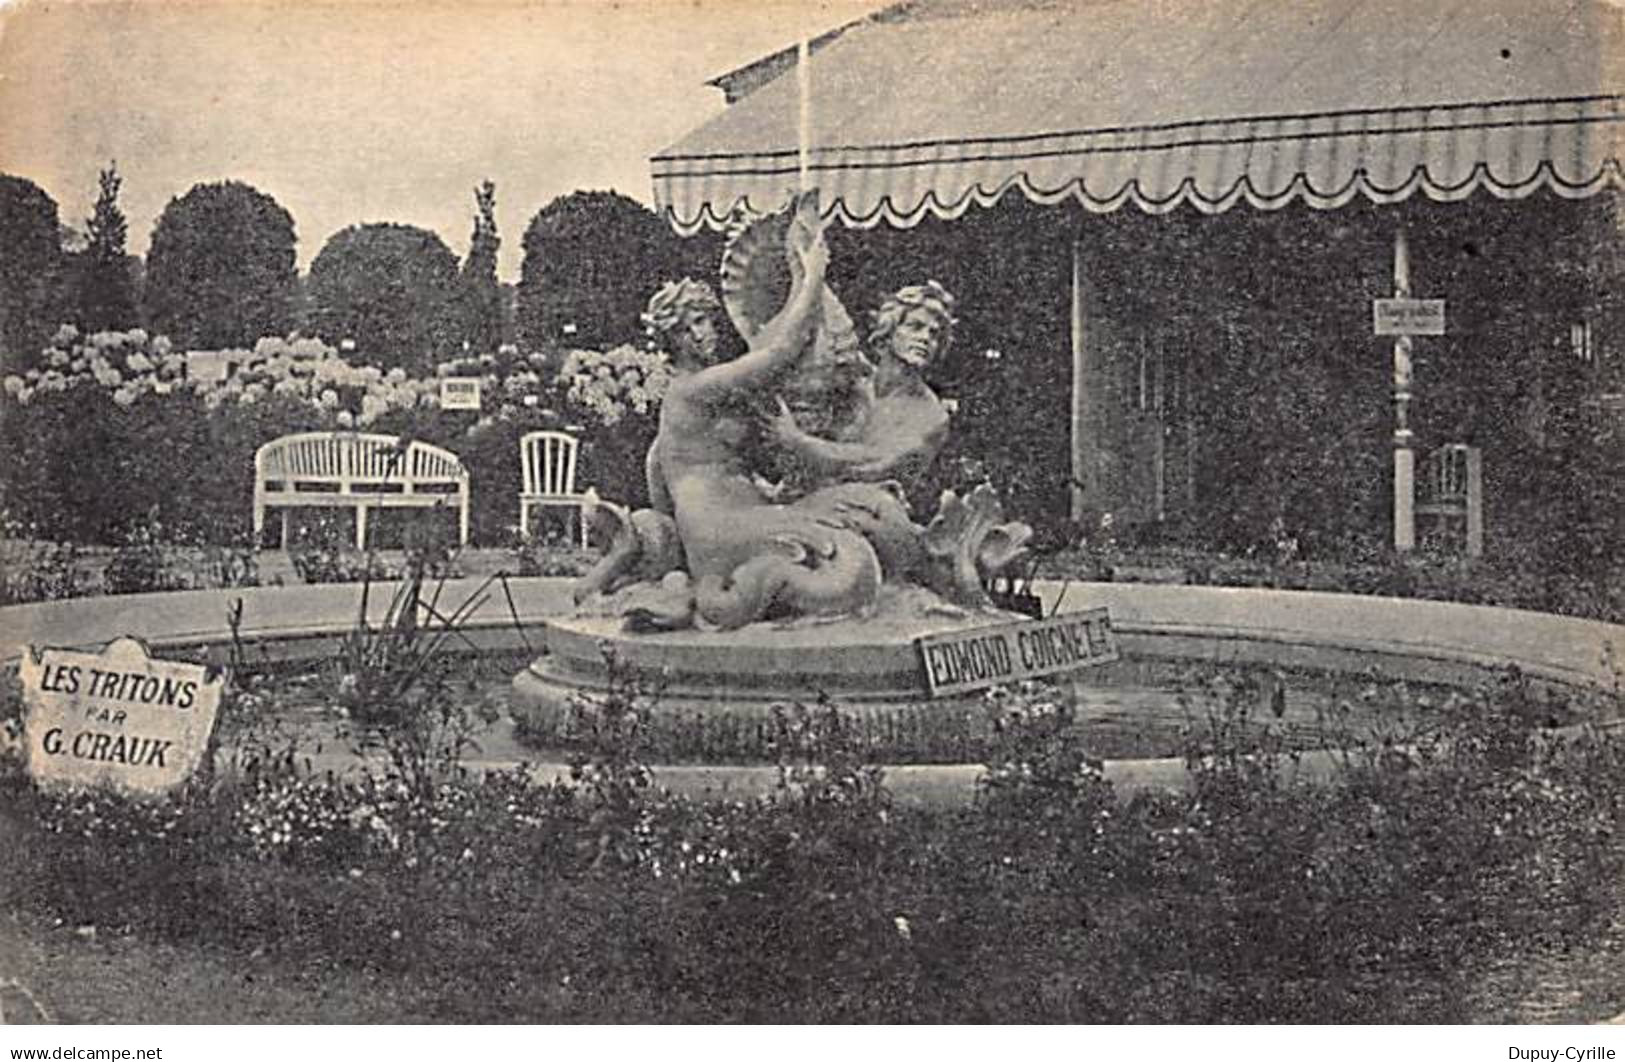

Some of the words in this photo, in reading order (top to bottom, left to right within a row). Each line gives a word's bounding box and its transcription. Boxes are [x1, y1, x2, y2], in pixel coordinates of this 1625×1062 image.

[928, 635, 1011, 687] EDMOND
[41, 665, 81, 694] LES
[89, 669, 198, 709] TRITONS
